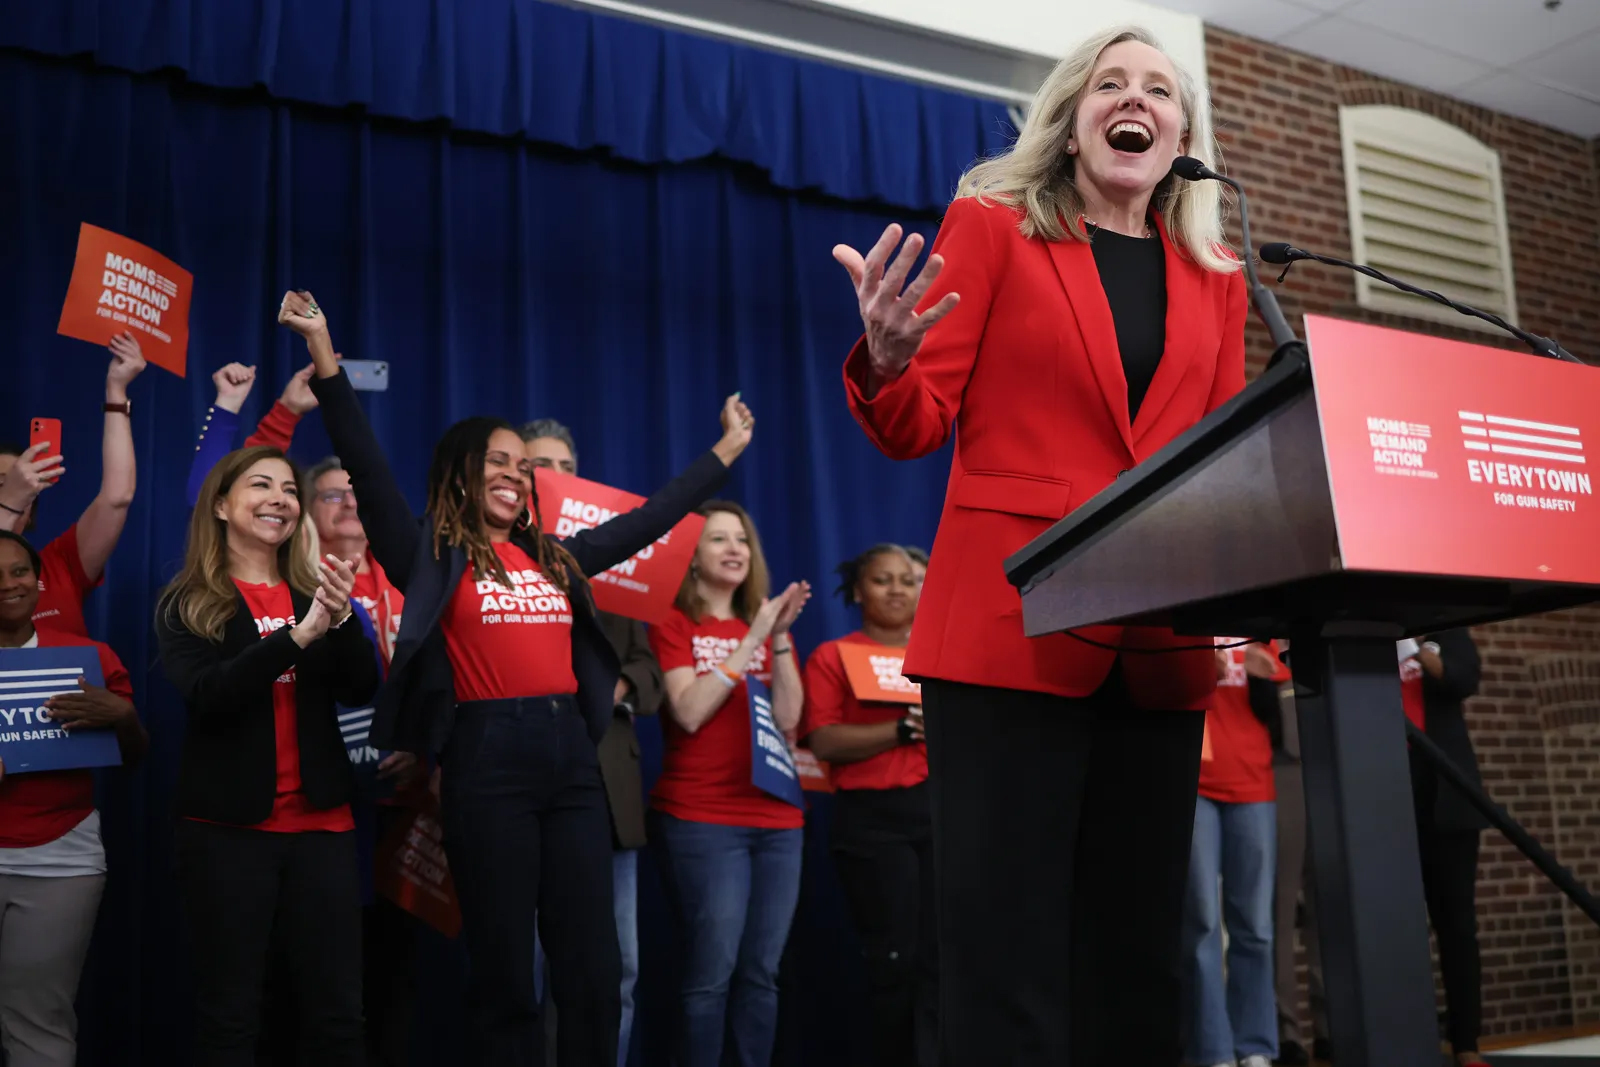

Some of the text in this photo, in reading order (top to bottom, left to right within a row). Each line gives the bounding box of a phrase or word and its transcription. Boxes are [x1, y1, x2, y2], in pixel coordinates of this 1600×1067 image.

[105, 252, 156, 286] MOMS
[102, 270, 169, 311] DEMAND
[98, 289, 161, 326] ACTION
[1367, 416, 1409, 436] MOMS
[1369, 433, 1428, 453] DEMAND
[1373, 449, 1423, 468] ACTION
[1467, 459, 1592, 495] EVERYTOWN
[1493, 492, 1576, 512] FOR GUN SAFETY
[481, 594, 568, 612] ACTION
[482, 614, 501, 624] FOR
[503, 613, 521, 623] GUN
[522, 614, 547, 624] SENSE
[23, 728, 69, 740] SAFETY
